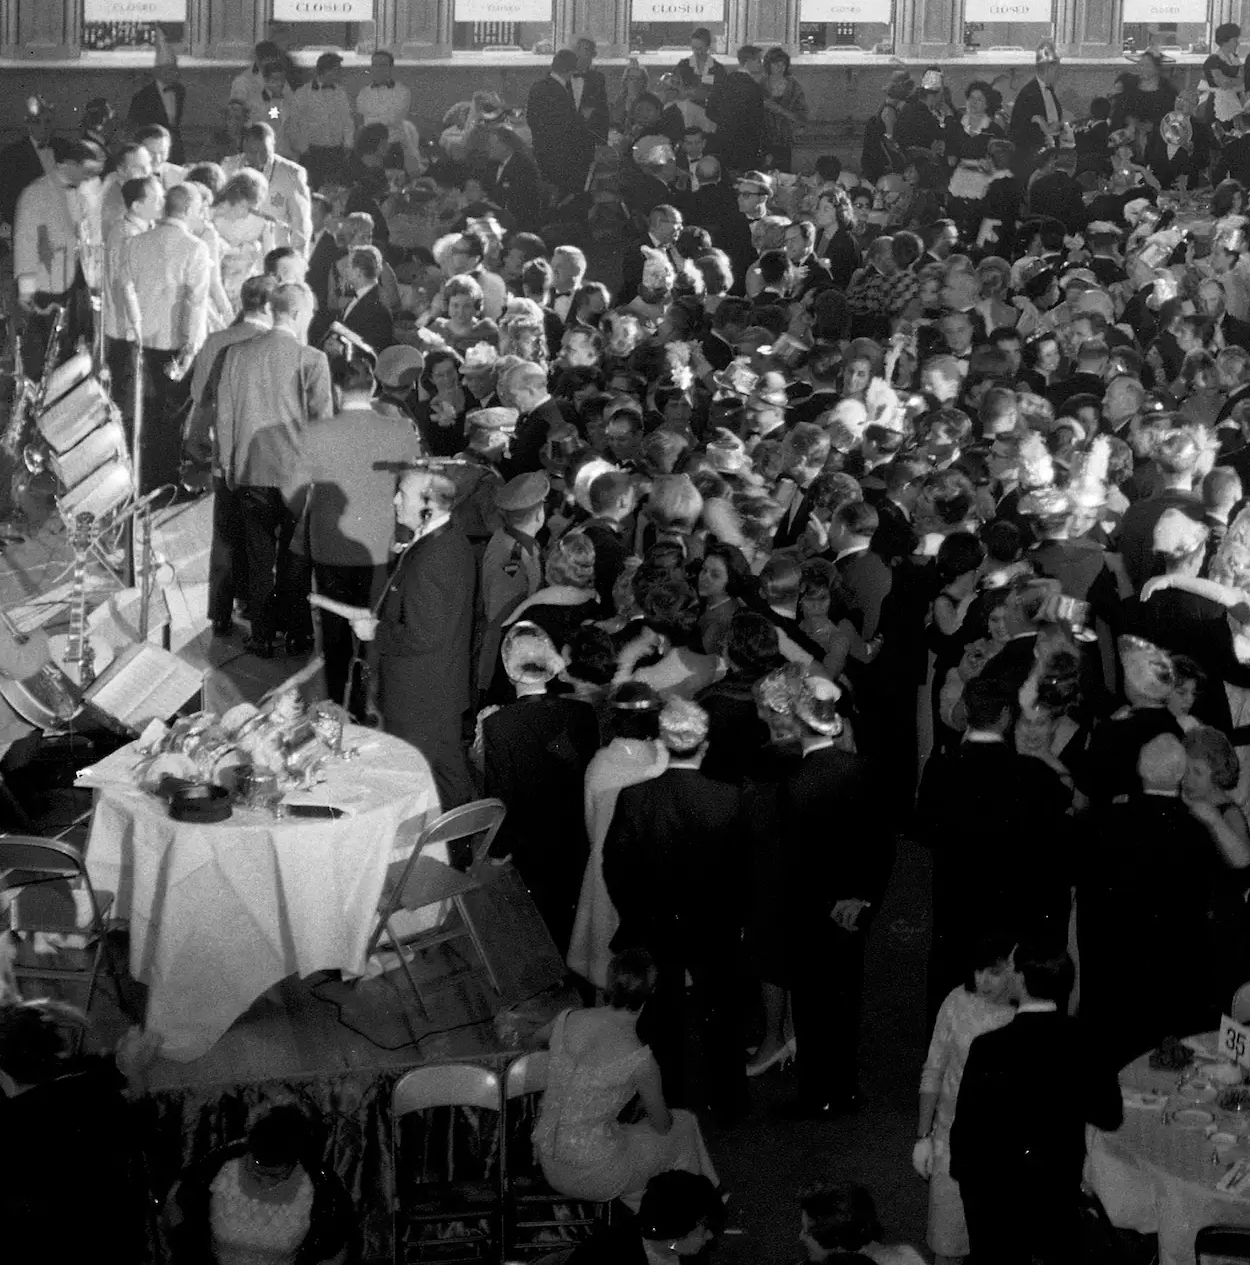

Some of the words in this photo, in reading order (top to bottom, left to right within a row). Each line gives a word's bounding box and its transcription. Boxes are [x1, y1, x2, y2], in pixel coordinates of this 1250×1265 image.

[295, 2, 352, 12] CLOSED
[652, 4, 704, 14] CLOSED
[989, 6, 1030, 14] CLOSED
[1226, 1027, 1246, 1057] 35
